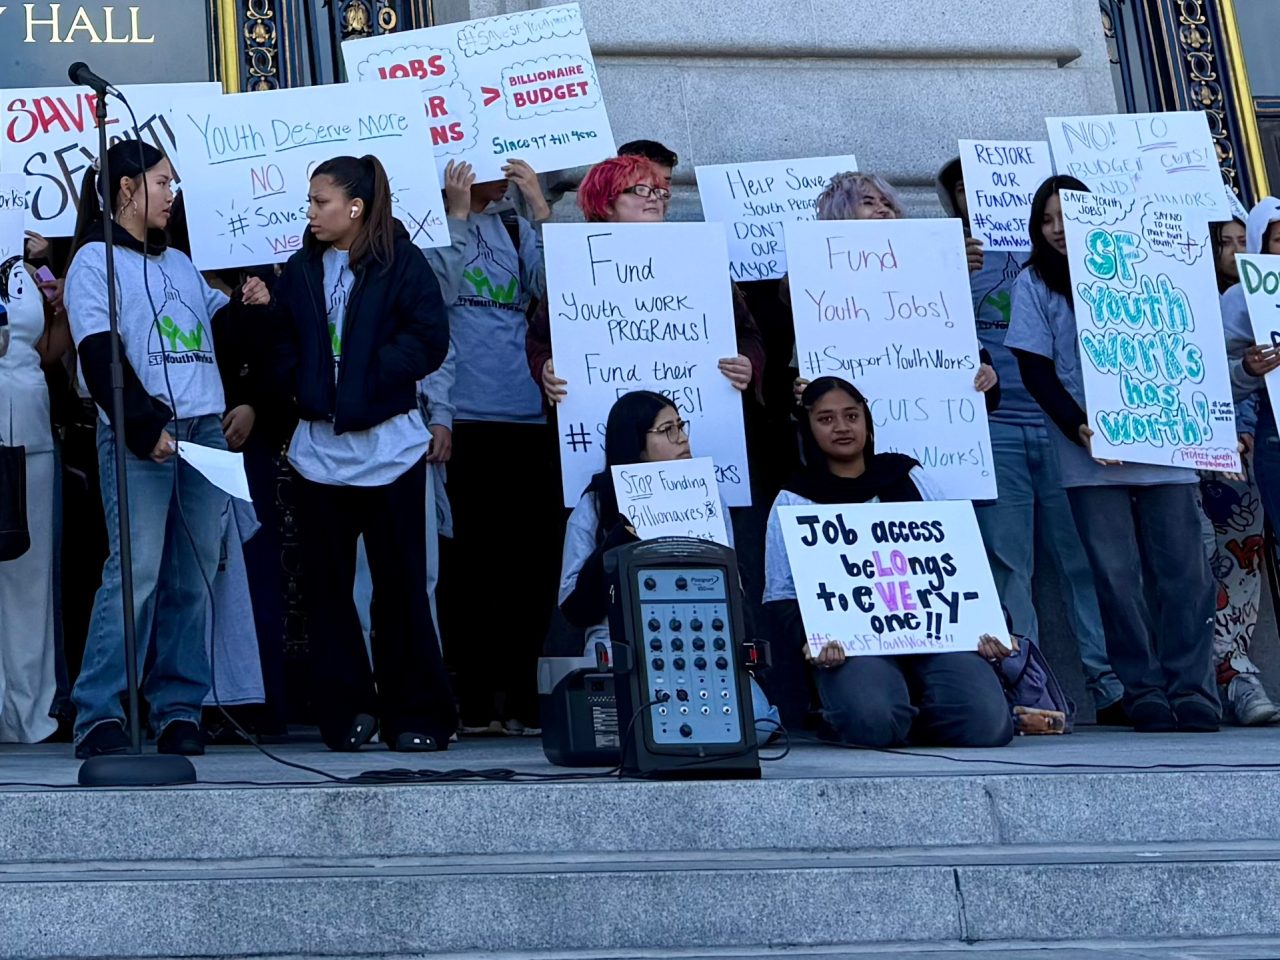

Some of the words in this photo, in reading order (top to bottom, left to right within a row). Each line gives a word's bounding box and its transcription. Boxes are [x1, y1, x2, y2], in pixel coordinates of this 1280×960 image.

[23, 2, 155, 43] HALL
[508, 64, 585, 87] BILLIONAIRE
[512, 80, 590, 109] BUDGET
[6, 93, 120, 143] SAVE
[1129, 116, 1169, 145] TO
[974, 143, 1036, 166] RESTORE
[250, 163, 285, 194] NO
[992, 171, 1021, 187] OUR
[1063, 191, 1088, 204] SAVE
[1169, 212, 1183, 222] NO
[587, 232, 656, 287] Fund
[825, 235, 899, 273] Fund
[1084, 228, 1148, 288] SF
[804, 288, 870, 324] Youth
[881, 289, 955, 329] Jobs!
[1077, 274, 1195, 333] Youth
[607, 313, 711, 346] PROGRAMS!
[584, 352, 641, 385] Fund
[651, 354, 698, 381] their
[1120, 371, 1181, 411] has
[871, 397, 930, 428] CUTS
[940, 397, 976, 424] TO
[620, 470, 653, 495] STOP
[658, 470, 709, 497] Funding
[796, 513, 859, 546] Job
[871, 520, 945, 543] access
[840, 549, 958, 592] beLOngs
[816, 582, 849, 612] to
[870, 611, 943, 640] one!!
